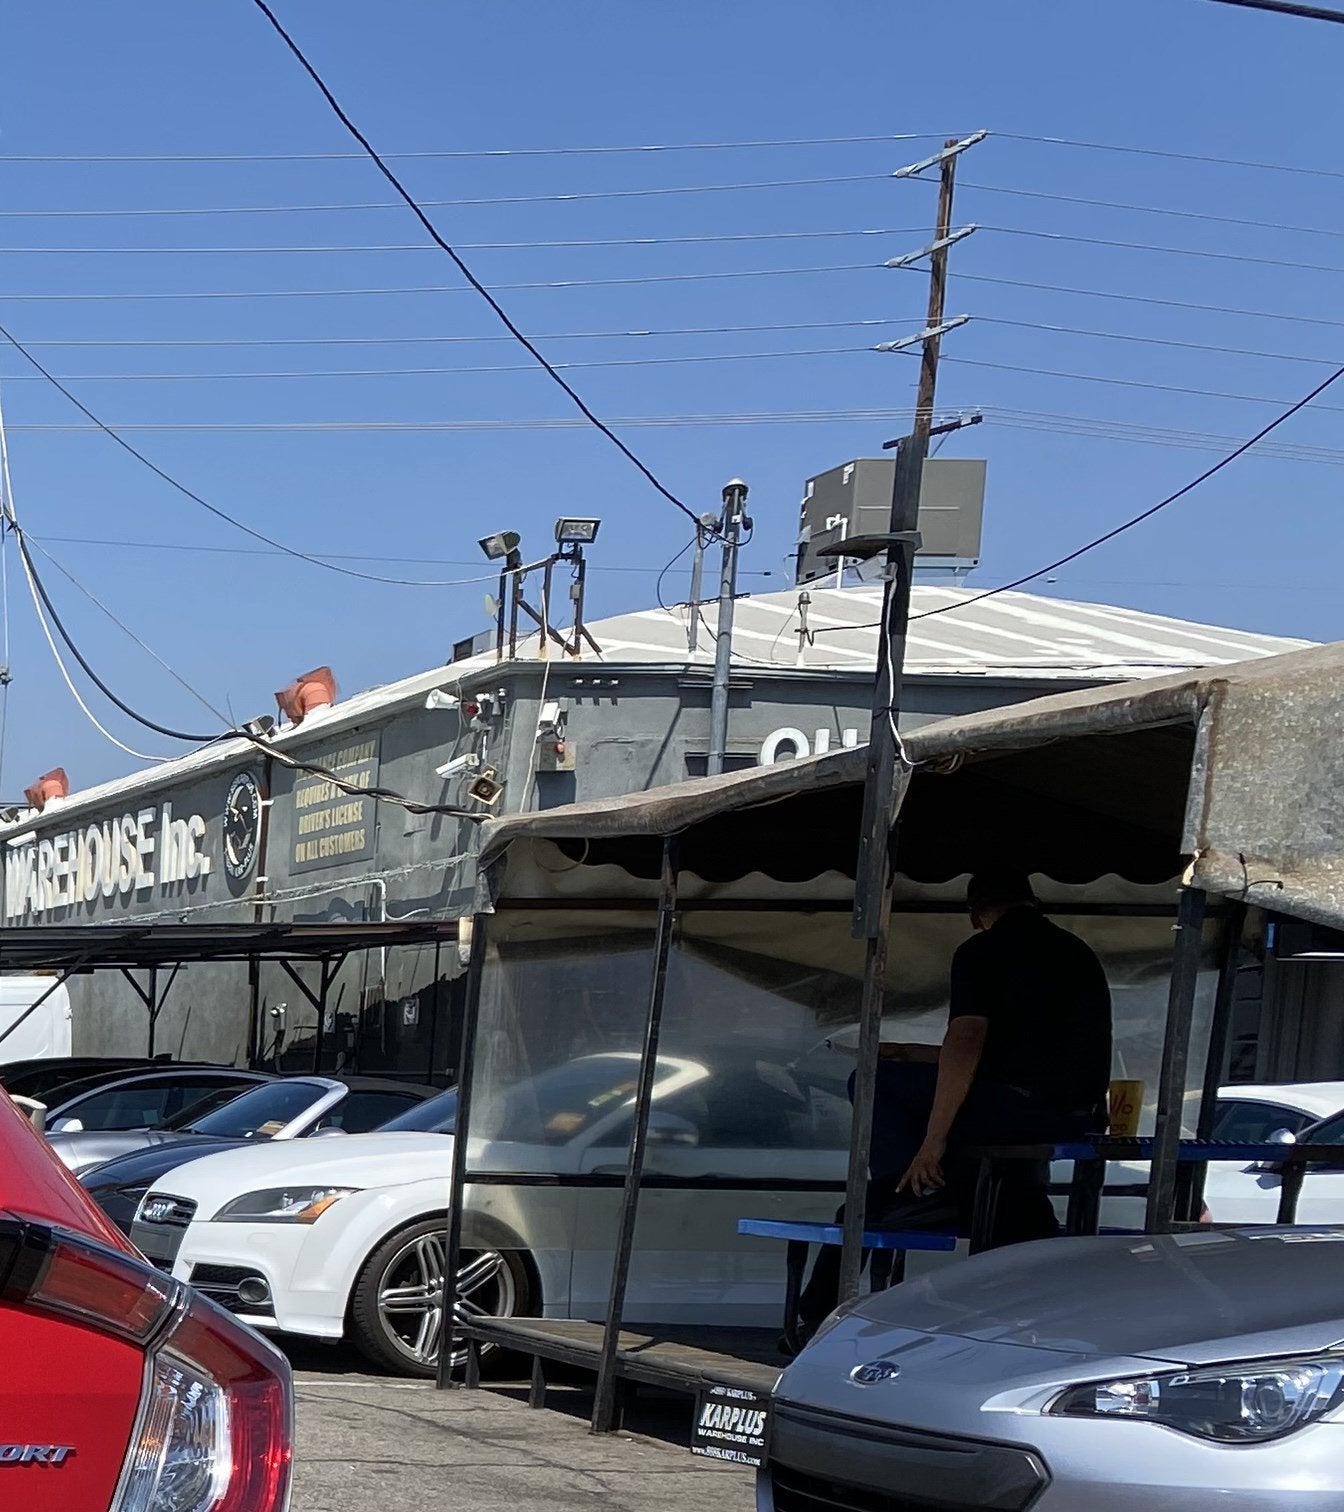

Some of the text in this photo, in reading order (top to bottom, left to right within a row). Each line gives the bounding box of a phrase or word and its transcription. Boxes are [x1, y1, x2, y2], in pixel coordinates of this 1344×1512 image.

[332, 800, 363, 827] LICENSE
[5, 806, 157, 918] WAREHOUSE
[159, 801, 211, 884] Inc.
[306, 839, 319, 860] ALL
[319, 828, 366, 858] CUSTOMERS
[699, 1402, 768, 1436] KARPLUS
[697, 1428, 765, 1447] WAREHOUSE INC
